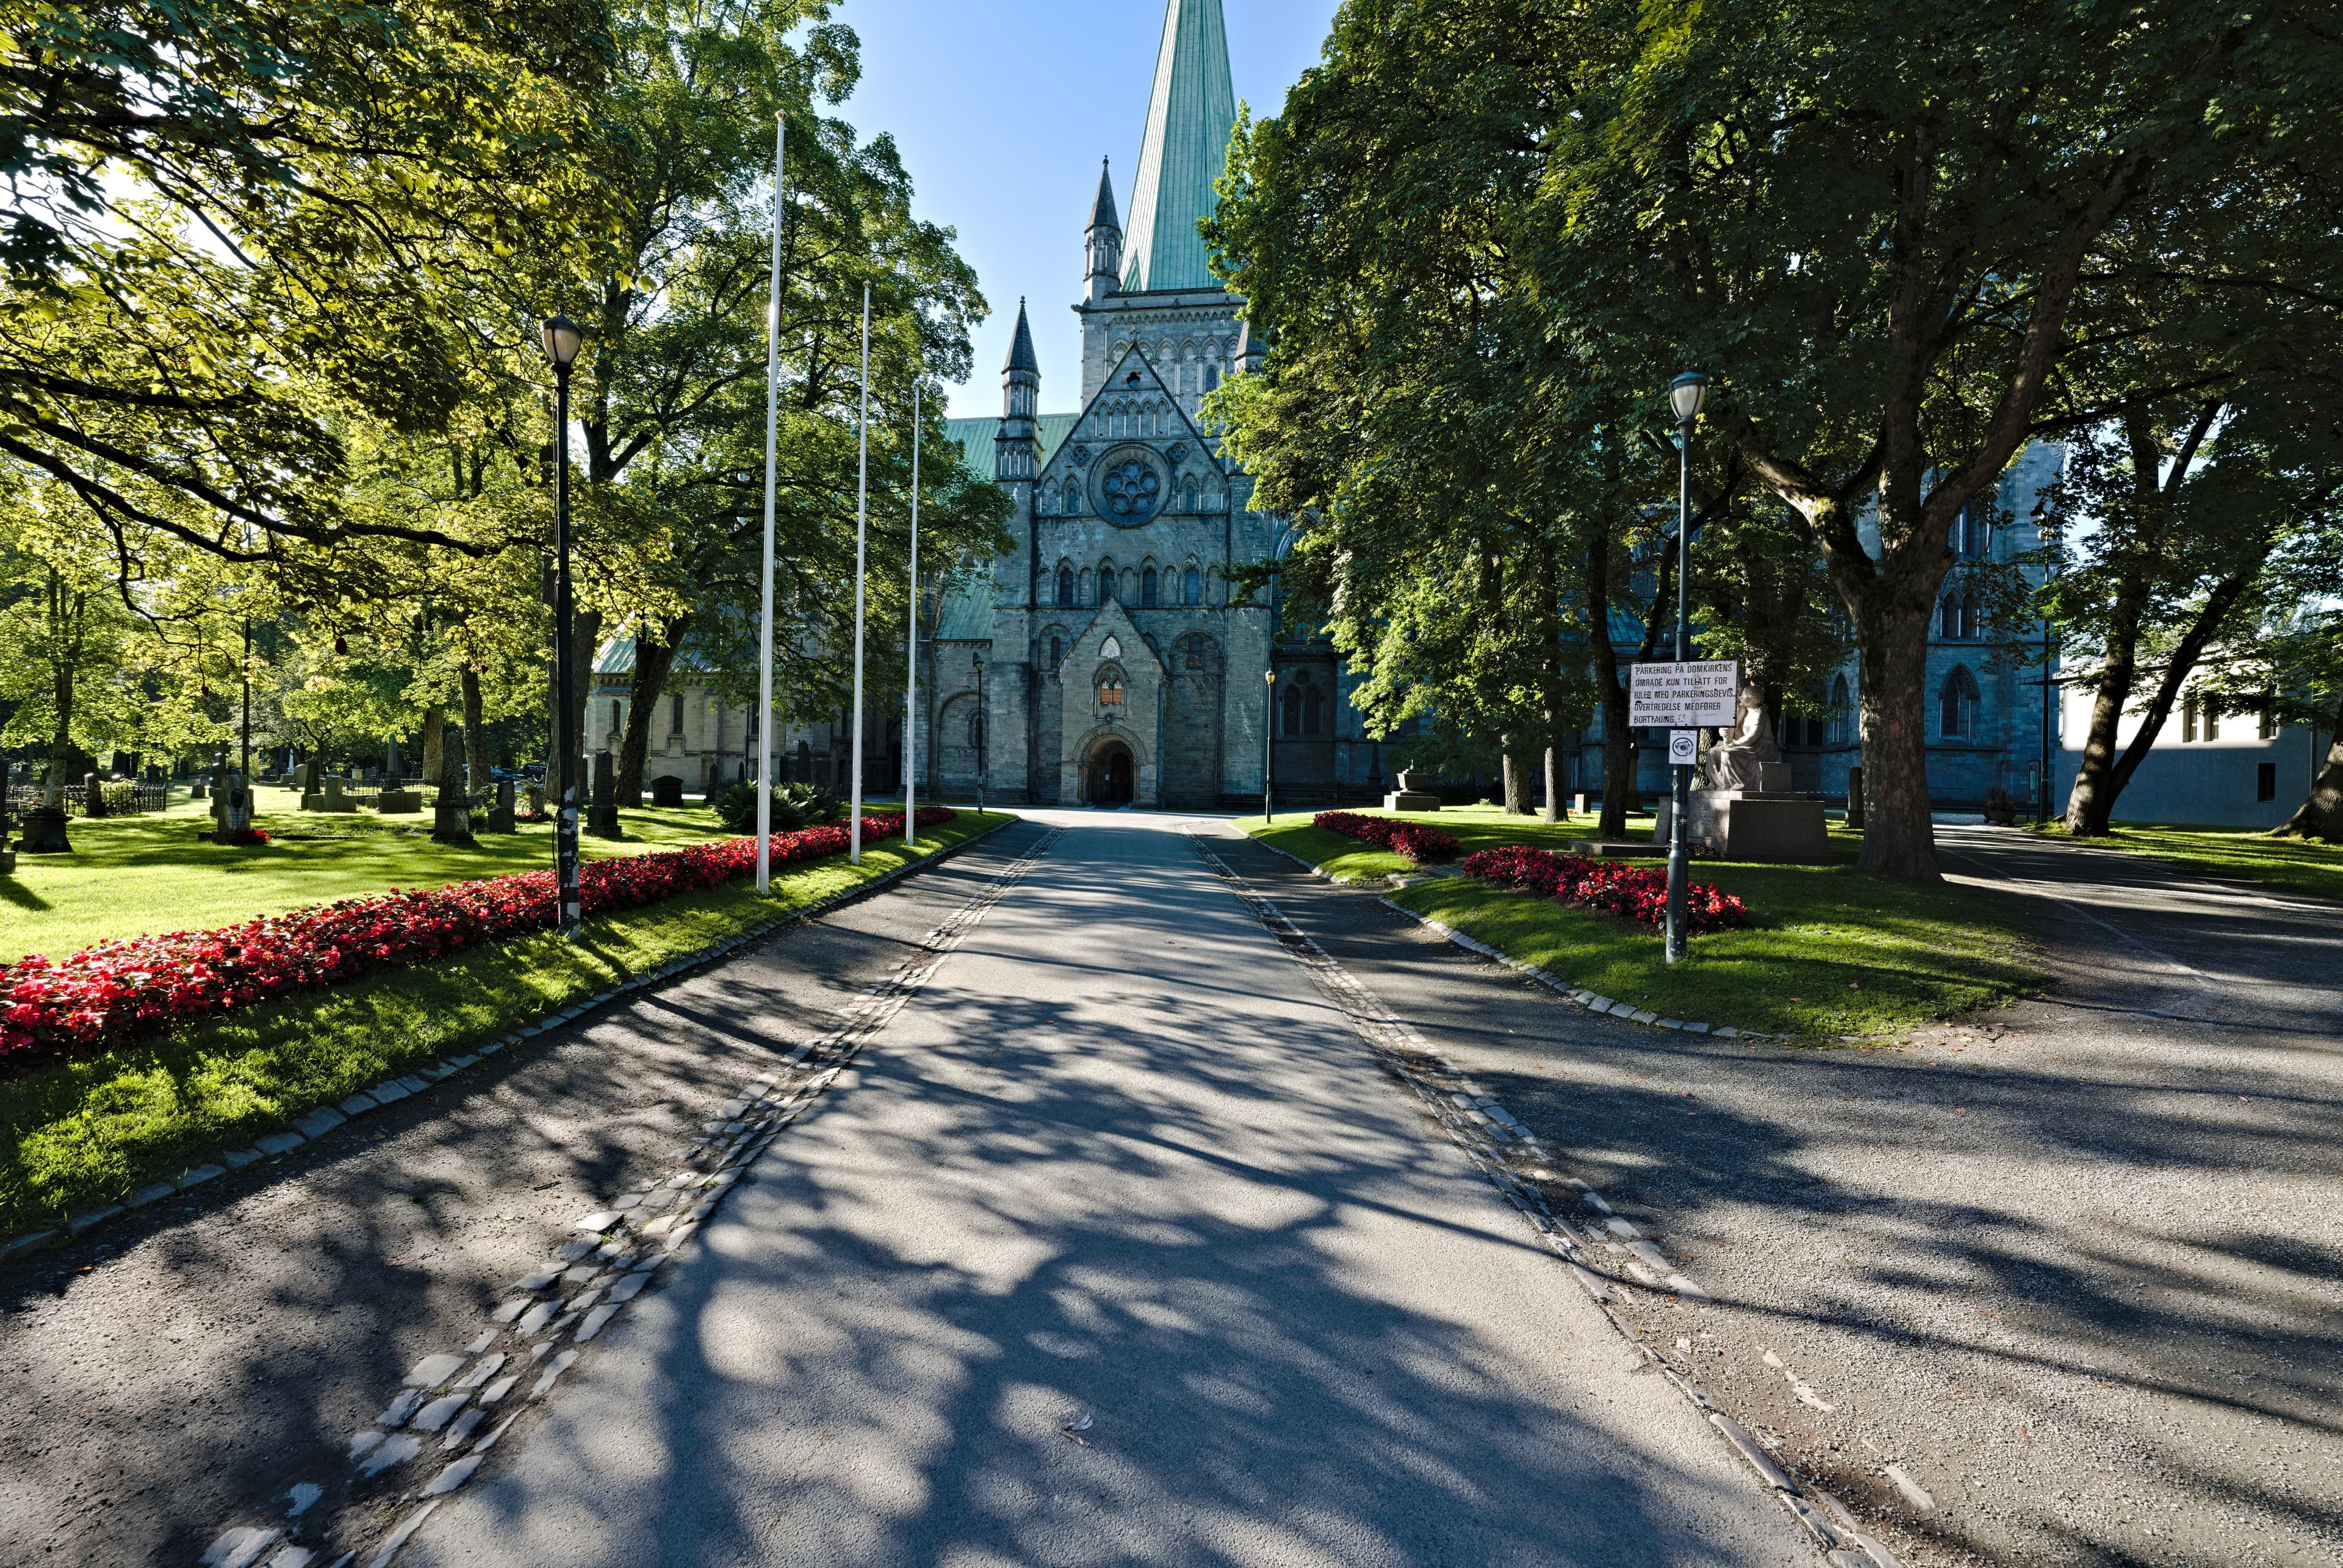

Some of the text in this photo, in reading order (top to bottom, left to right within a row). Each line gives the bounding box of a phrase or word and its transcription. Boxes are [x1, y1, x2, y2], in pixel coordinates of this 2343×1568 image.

[1635, 666, 1672, 675] PARKERING
[1687, 664, 1732, 674] DOMKIRKENS
[1666, 678, 1680, 686] KUN
[1683, 677, 1711, 686] TILLATT
[1634, 702, 1721, 711] OVERTREDELSE MEDFØRER
